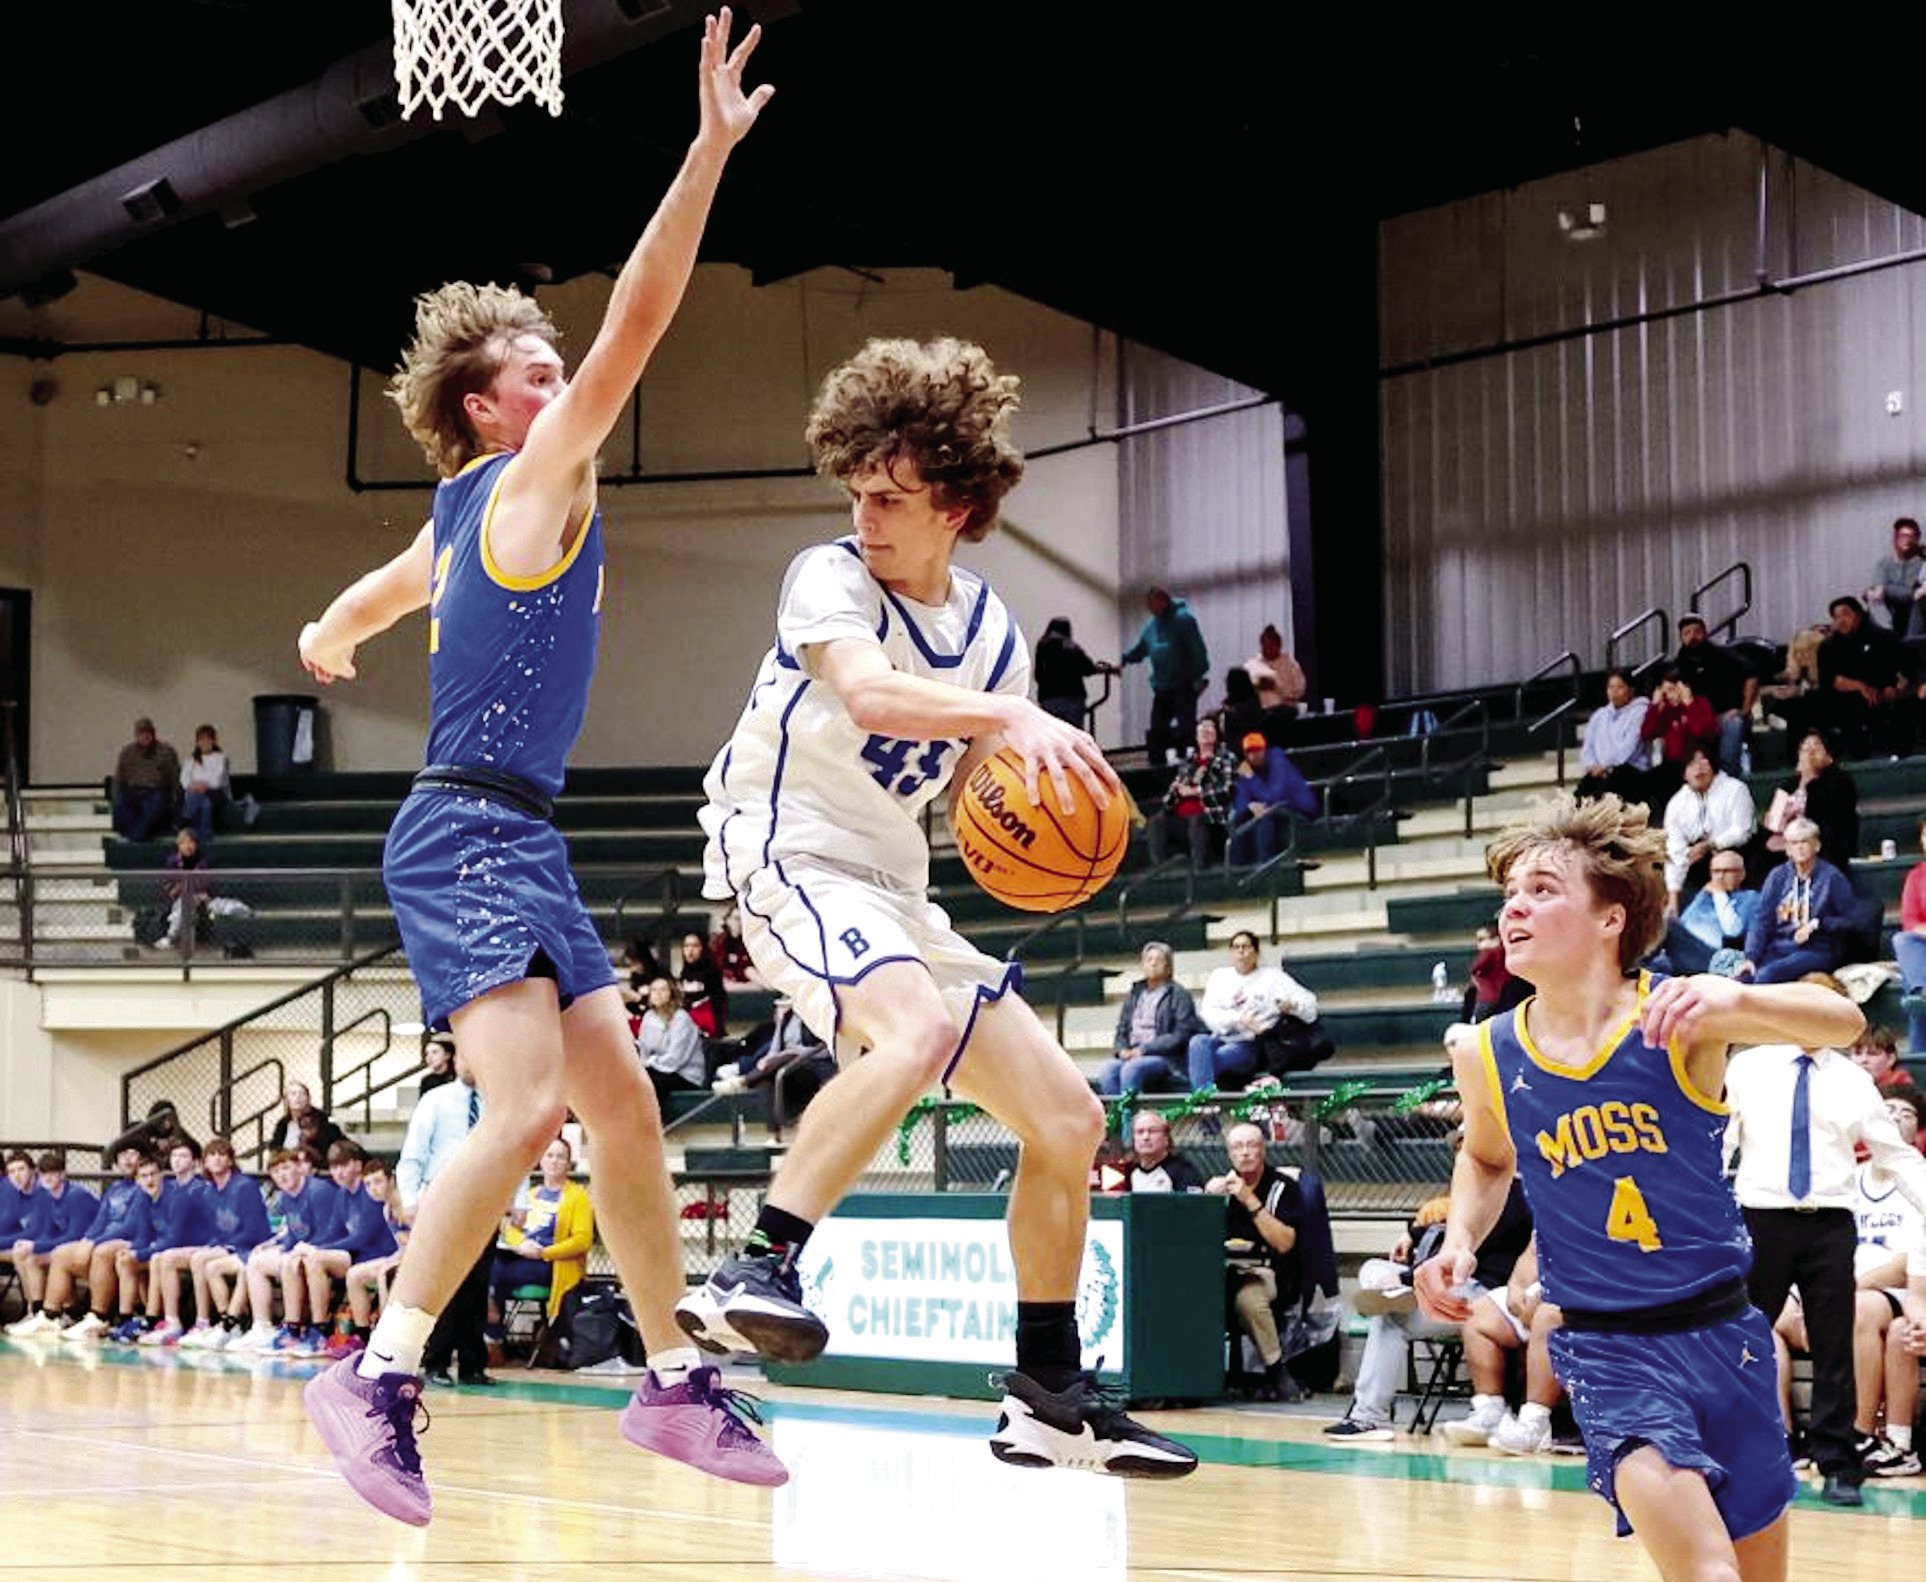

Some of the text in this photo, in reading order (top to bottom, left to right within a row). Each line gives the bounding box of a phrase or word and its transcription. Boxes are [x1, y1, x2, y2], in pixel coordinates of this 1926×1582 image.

[969, 763, 1036, 850] Wilson
[838, 927, 870, 960] B
[1535, 1101, 1668, 1179] MOSS
[1606, 1175, 1663, 1253] 4
[861, 1239, 1016, 1283] SEMINOL
